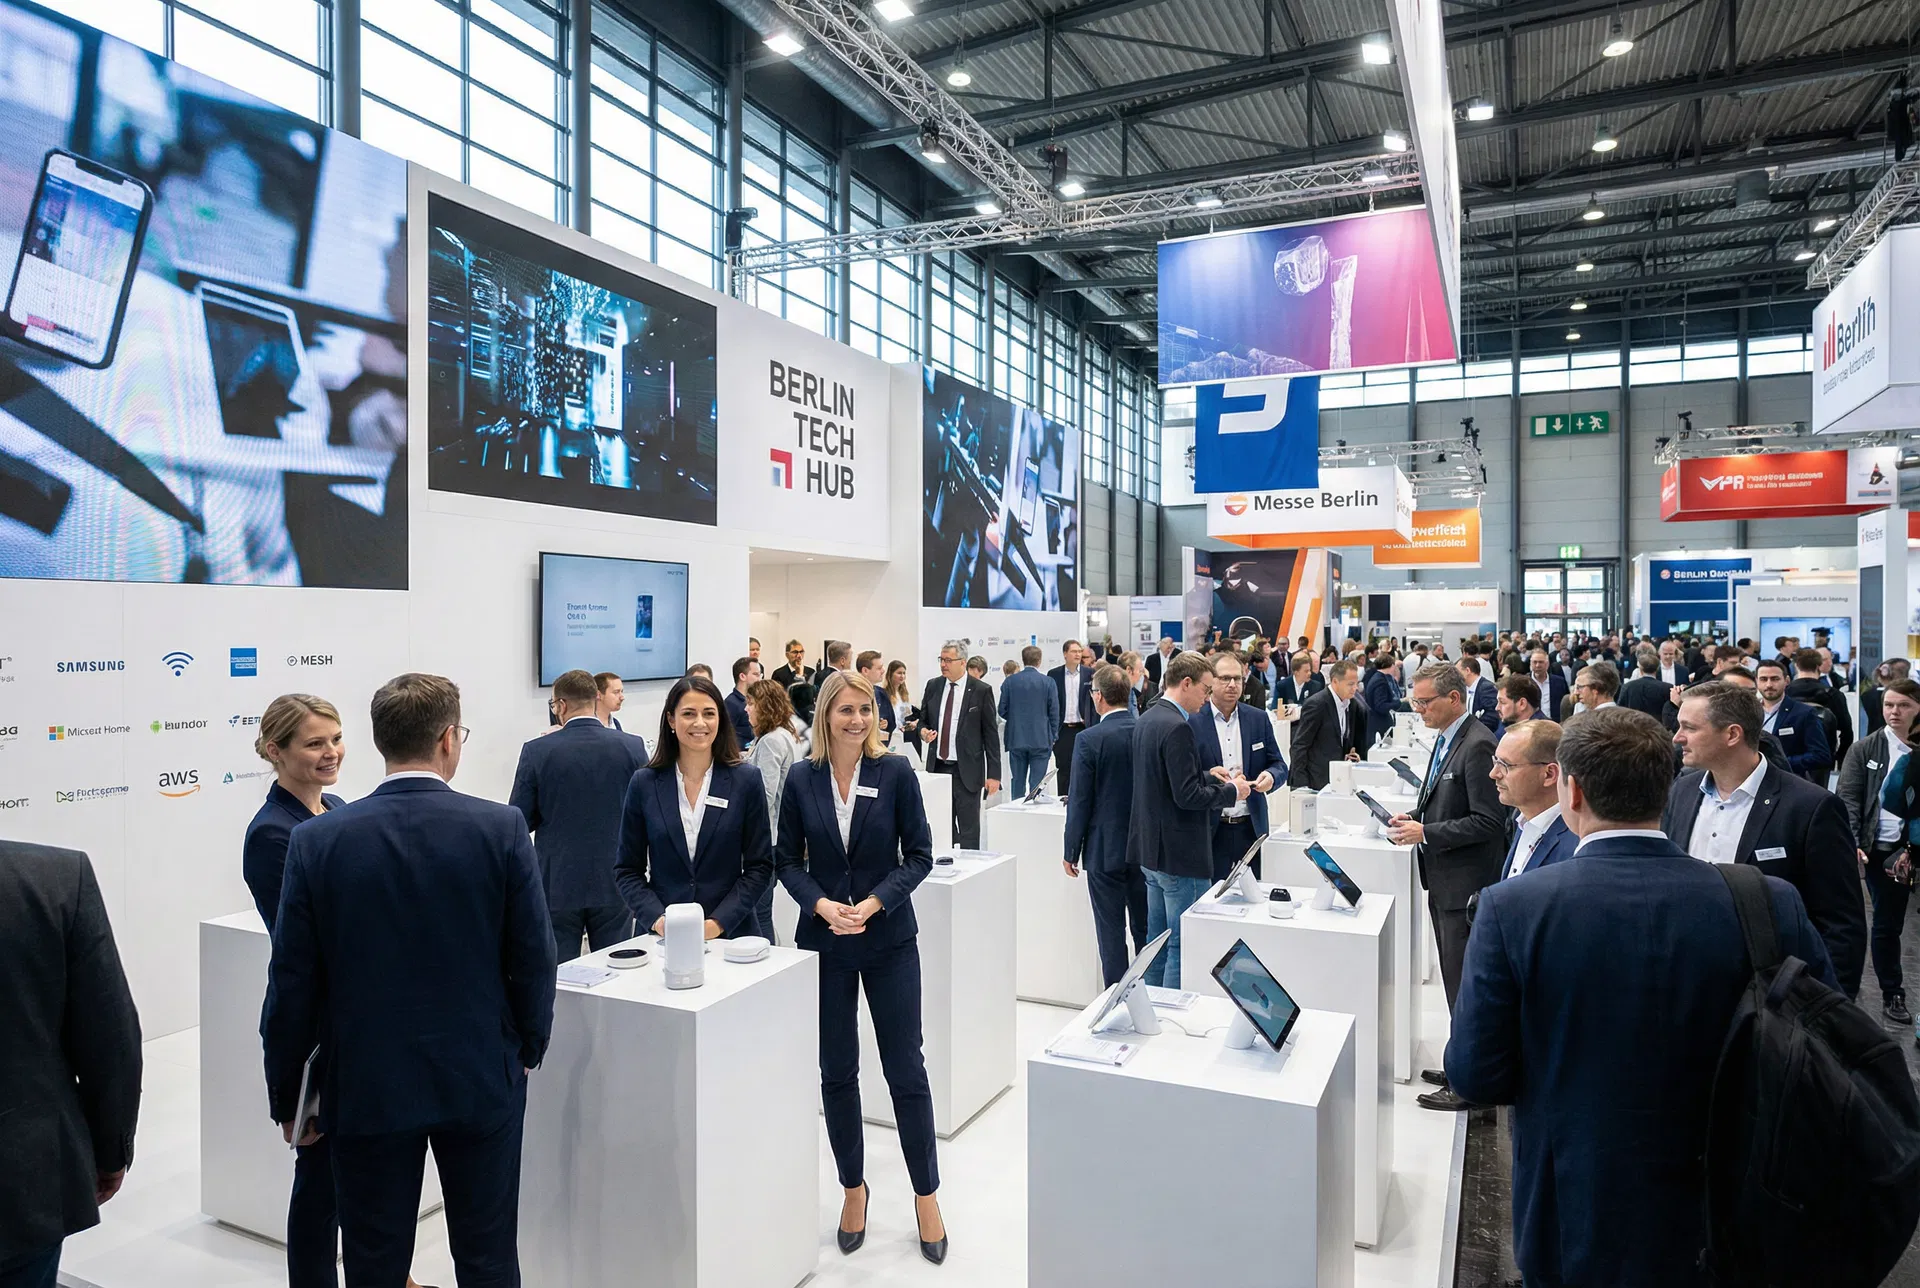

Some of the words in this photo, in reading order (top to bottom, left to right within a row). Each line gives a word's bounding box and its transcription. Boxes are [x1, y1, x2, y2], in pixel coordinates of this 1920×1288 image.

[1838, 296, 1875, 361] Berlin
[770, 359, 854, 421] BERLIN
[793, 411, 854, 460] TECH
[806, 458, 854, 500] HUB
[1254, 494, 1315, 511] Messe
[1321, 489, 1379, 508] Berlin
[57, 660, 125, 673] SAMSUNG
[301, 655, 333, 666] MESH
[104, 725, 131, 734] Home
[158, 769, 199, 788] aws
